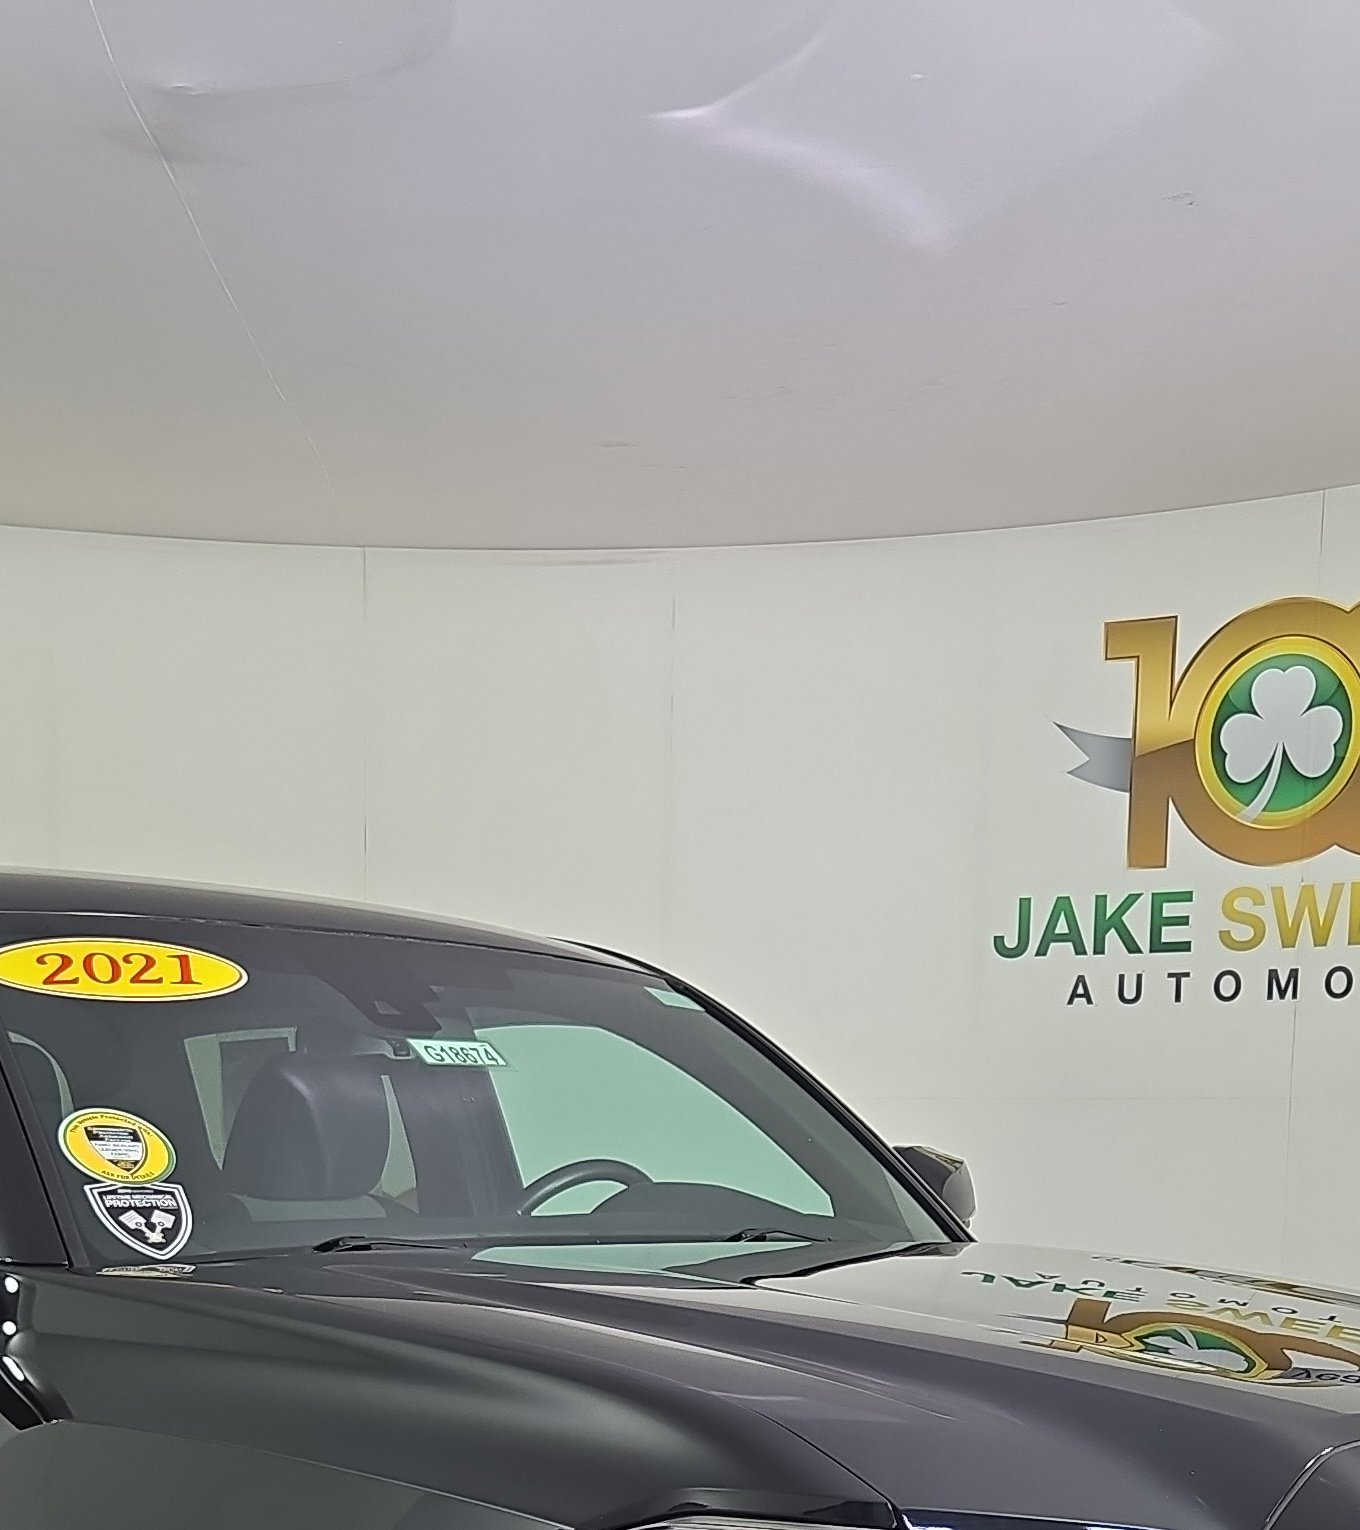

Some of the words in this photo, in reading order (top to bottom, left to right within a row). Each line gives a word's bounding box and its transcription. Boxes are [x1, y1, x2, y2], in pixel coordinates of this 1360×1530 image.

[993, 890, 1193, 960] JAKE
[36, 952, 202, 985] 2021
[424, 1044, 500, 1064] G18674
[104, 1198, 178, 1208] PROTECTION
